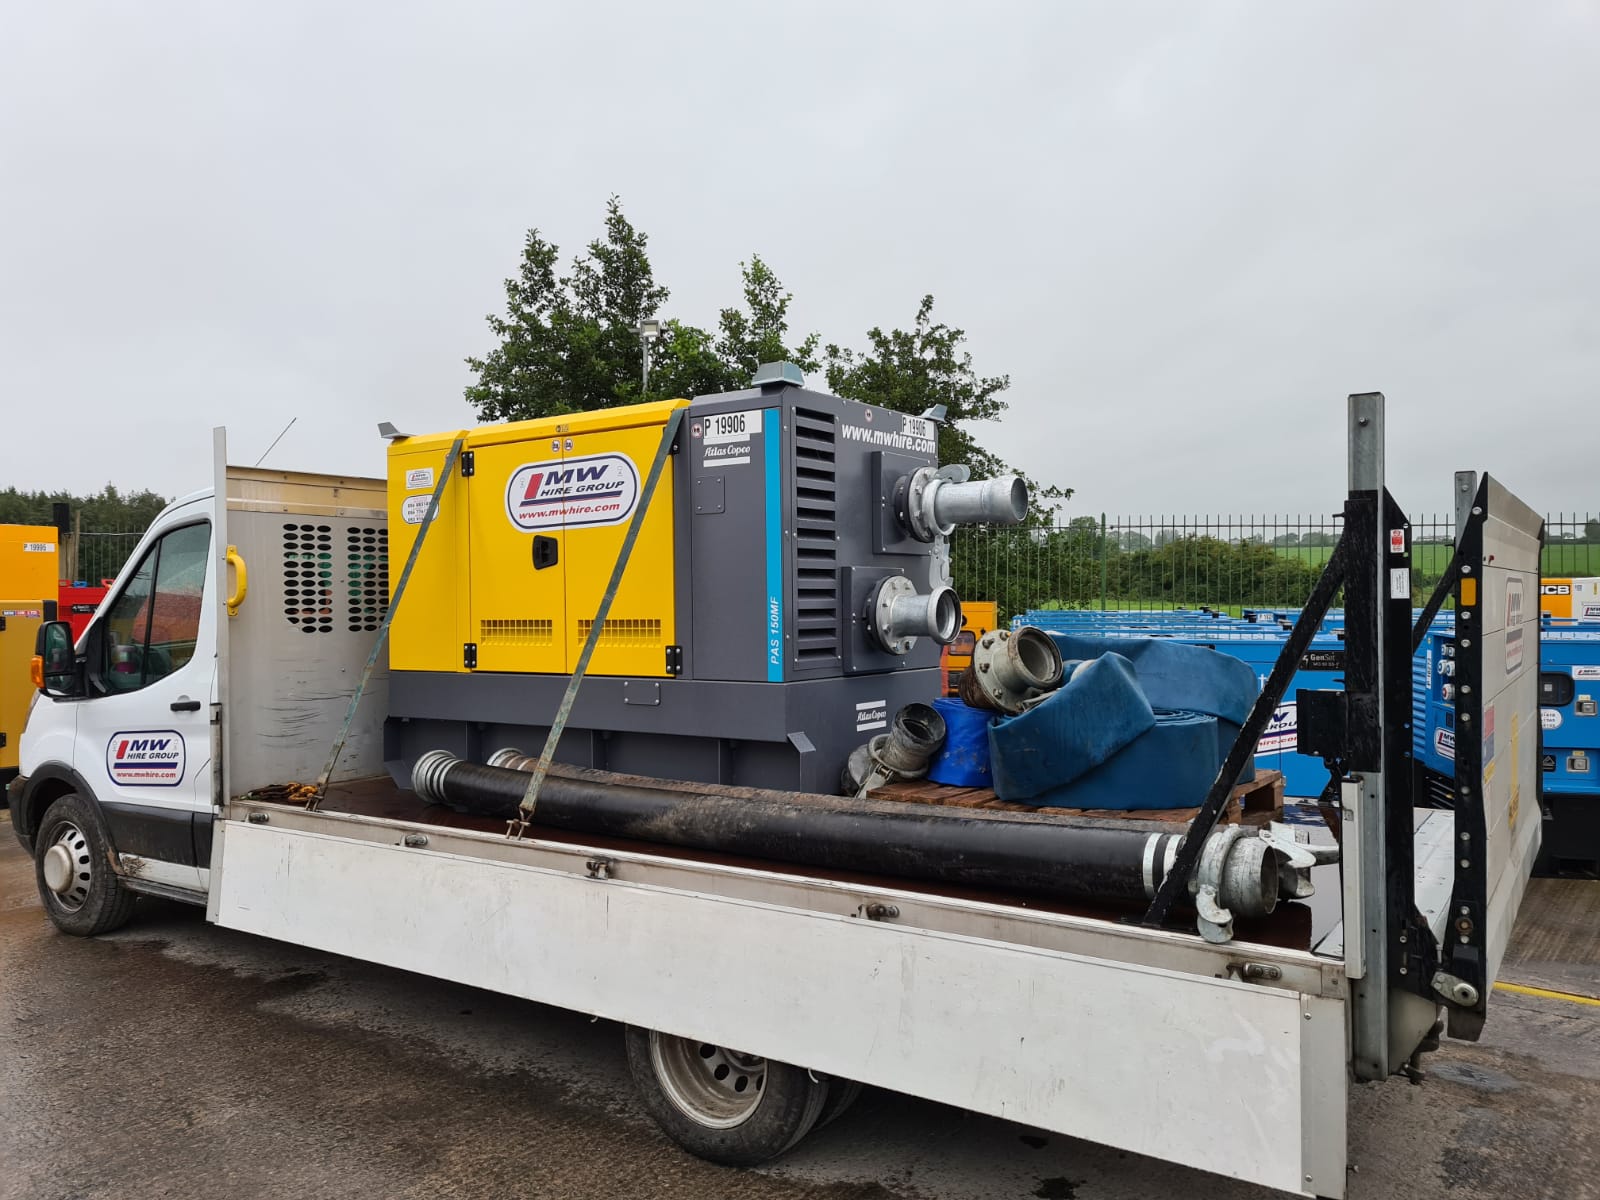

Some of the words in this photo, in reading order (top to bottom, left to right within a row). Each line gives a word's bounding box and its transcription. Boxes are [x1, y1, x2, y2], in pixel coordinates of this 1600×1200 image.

[704, 418, 711, 437] P
[715, 414, 746, 435] 19906
[902, 417, 907, 433] P
[841, 424, 936, 454] www.mwhire.com
[704, 446, 727, 457] Atlas
[727, 444, 751, 456] Copco
[545, 464, 609, 486] MW
[540, 485, 573, 497] HIRE
[576, 480, 625, 493] GROUP
[519, 503, 620, 520] www.mwhire.com
[770, 596, 780, 635] 150MF
[770, 639, 780, 665] PAS
[871, 710, 887, 721] Copco
[129, 739, 171, 752] MW
[127, 752, 147, 760] HIRE
[148, 752, 179, 760] GROUP
